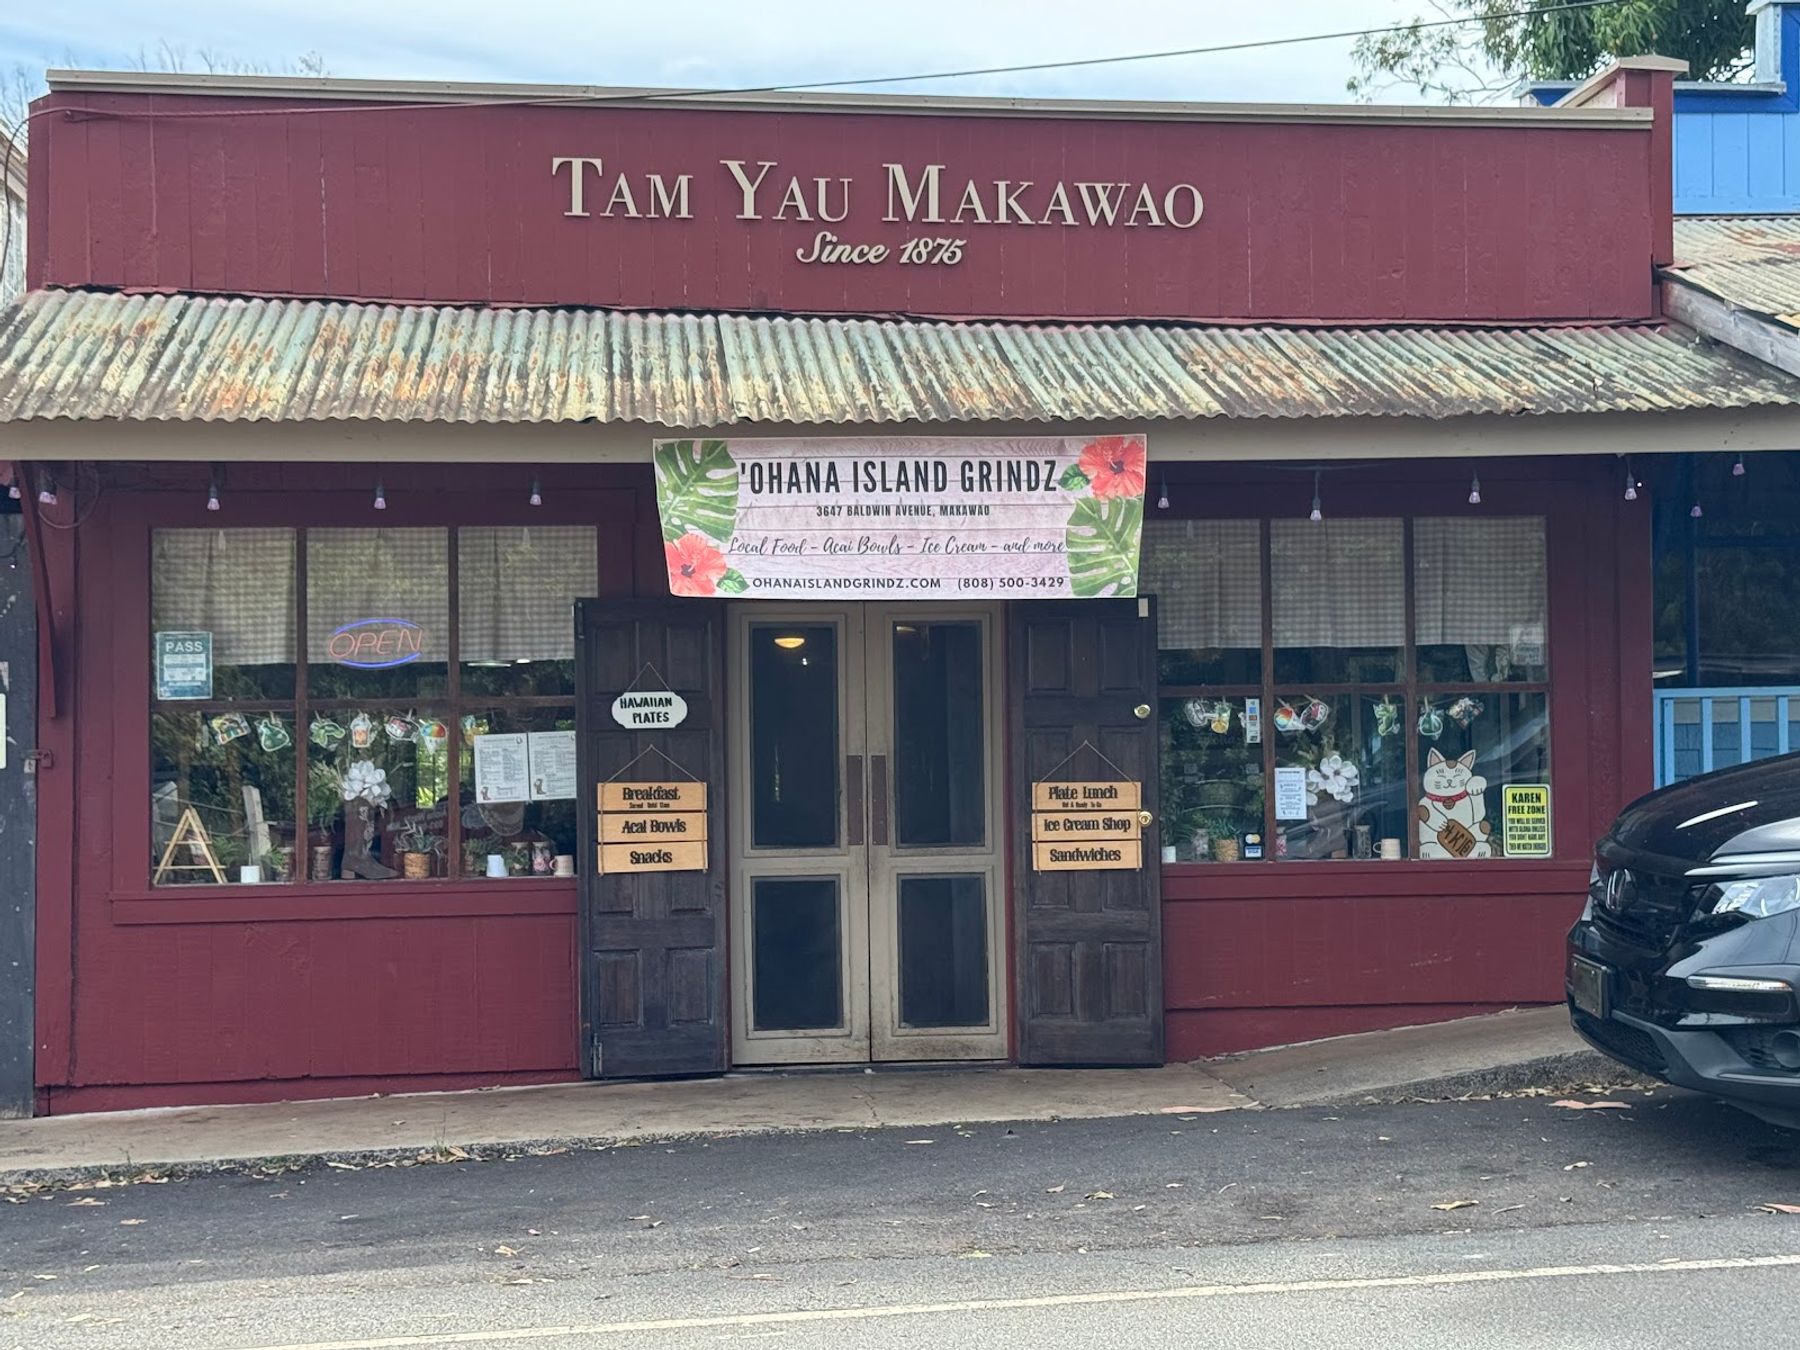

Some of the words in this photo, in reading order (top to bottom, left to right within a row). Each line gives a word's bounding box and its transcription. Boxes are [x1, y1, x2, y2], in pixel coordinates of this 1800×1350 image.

[796, 231, 890, 266] Since
[898, 236, 967, 266] 1875
[741, 461, 841, 494] 'OHANA
[852, 460, 948, 493] ISLAND
[960, 459, 1057, 493] GRINDZ
[816, 505, 842, 517] 3647
[847, 505, 891, 517] BALDWIN
[895, 505, 936, 518] AVENUE,
[939, 504, 990, 516] MAKAWAO
[728, 536, 768, 556] Local
[771, 537, 808, 556] Food
[823, 537, 854, 555] Acai
[857, 535, 903, 556] Bowls
[920, 536, 941, 554] Ice
[944, 535, 988, 555] Cream
[1003, 537, 1031, 554] and
[1033, 541, 1066, 553] more
[752, 577, 941, 589] OHANAISLANDGRINDZ.COM
[958, 577, 994, 591] (808)
[999, 577, 1065, 589] 500-3429
[165, 641, 204, 653] PASS
[329, 628, 423, 658] OPEN
[619, 696, 673, 709] HAWAIIAN
[632, 711, 670, 724] PLATES
[622, 785, 681, 801] Breakfast
[1048, 785, 1078, 800] Plate
[1082, 785, 1118, 799] Lunch
[1511, 792, 1542, 804] KAREN
[1508, 806, 1525, 814] FREE
[1527, 806, 1546, 814] ZONE
[621, 820, 647, 834] Acai
[650, 818, 687, 833] Bowls
[1043, 818, 1060, 832] Ice
[1063, 818, 1099, 831] Cream
[1102, 817, 1131, 832] Shop
[630, 849, 673, 864] Snacks
[1049, 847, 1121, 862] Sandwiches
